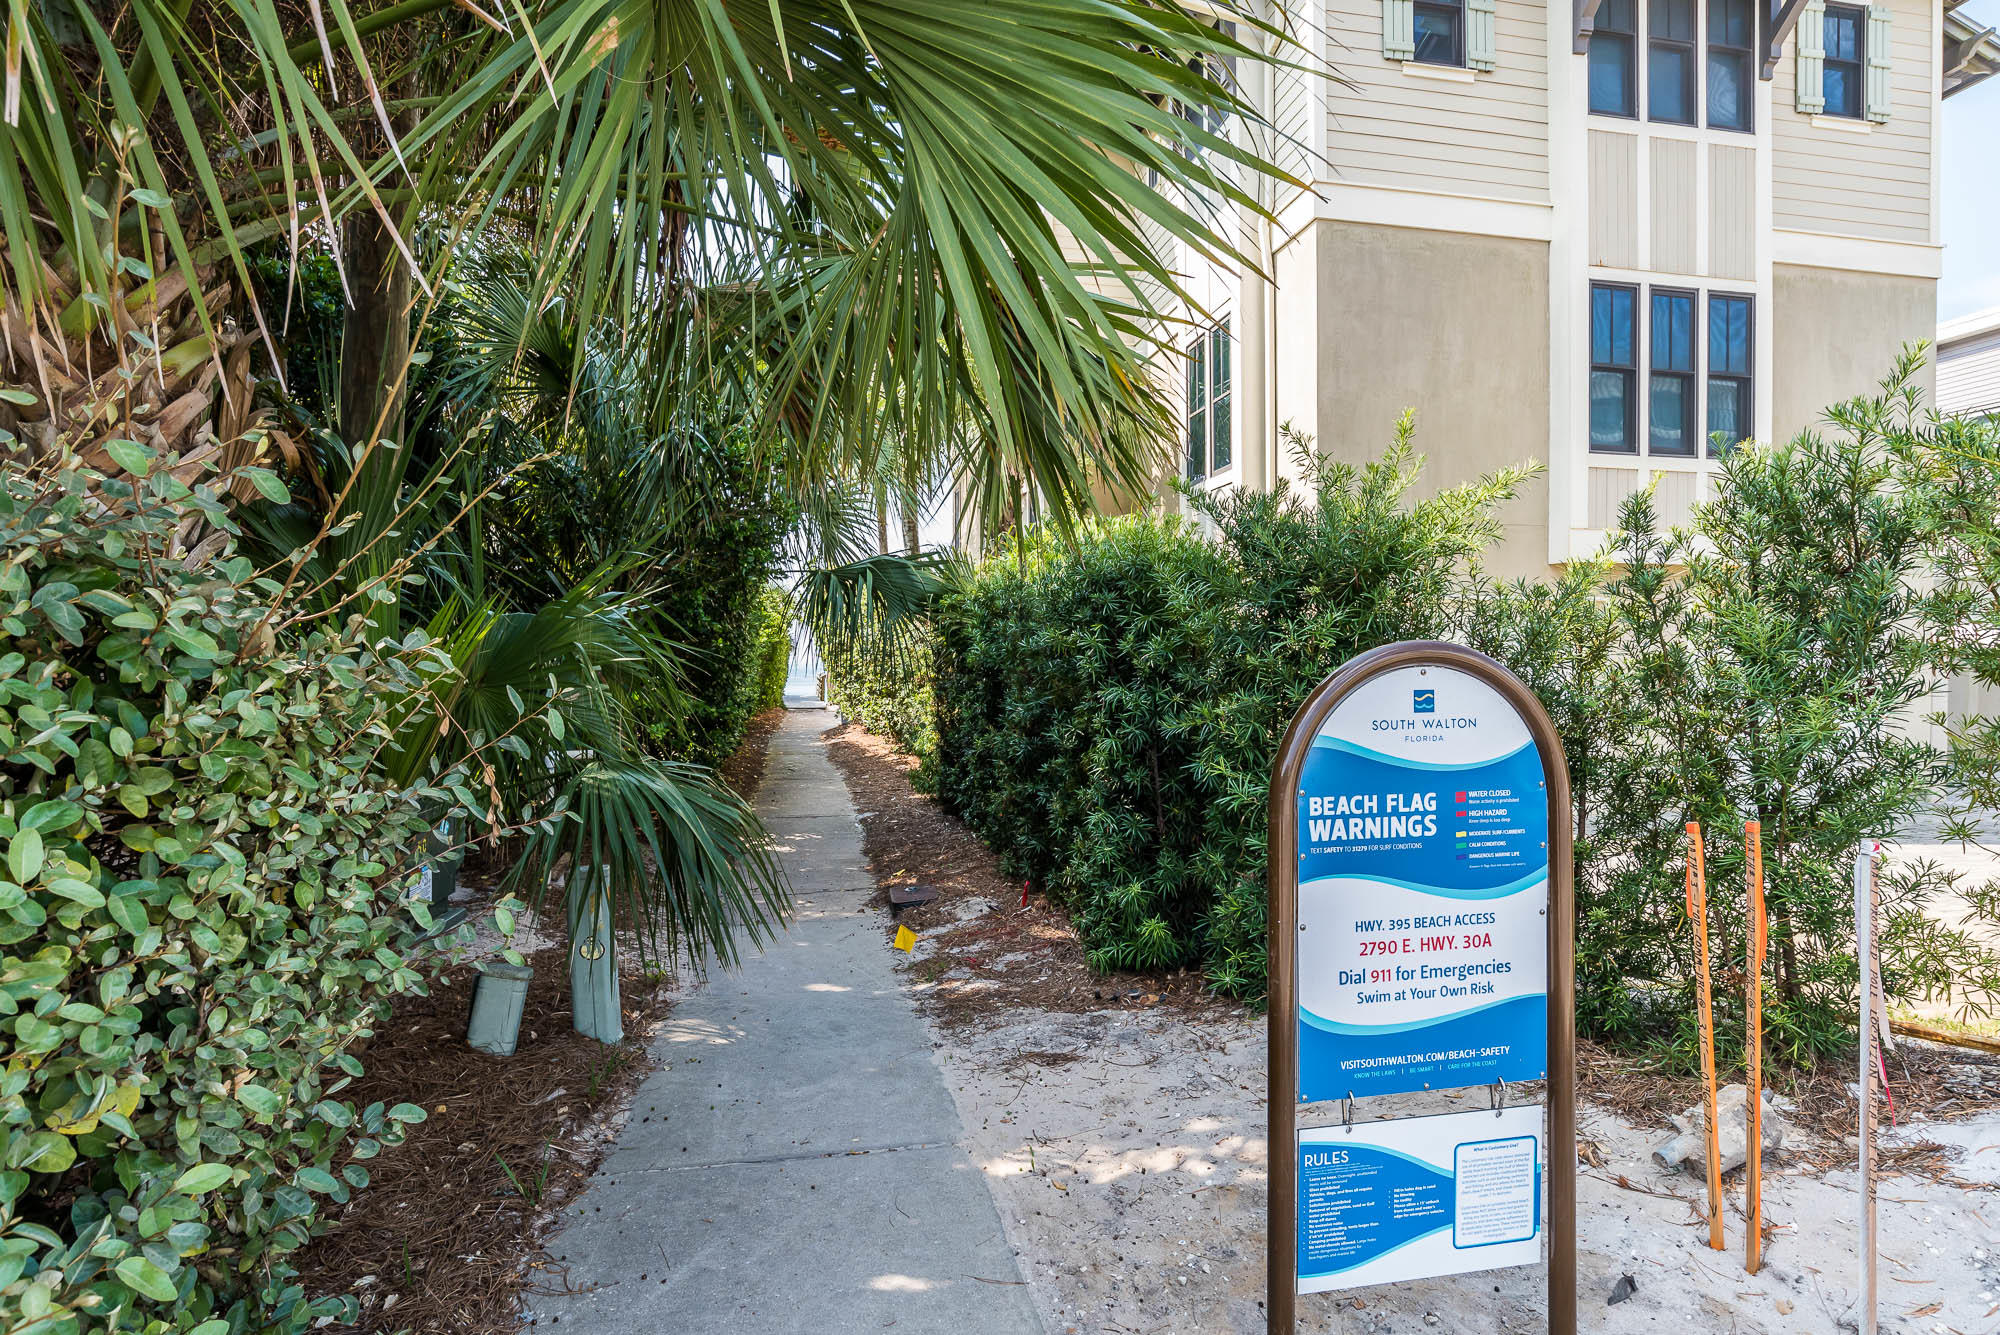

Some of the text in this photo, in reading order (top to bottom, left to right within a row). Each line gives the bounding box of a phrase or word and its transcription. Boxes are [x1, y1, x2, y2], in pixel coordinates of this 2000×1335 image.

[1372, 718, 1478, 731] SOUTH WALTON
[1310, 792, 1436, 816] BEACH FLAG
[1308, 814, 1437, 842] WARNINGS
[1355, 912, 1496, 932] HWY. 395 BEACH ACCESS
[1870, 902, 1878, 960] PROPOSED
[1359, 932, 1492, 956] 2790 E. HWY. 30A
[1338, 959, 1512, 986] Dial 911 for Emergencies
[1869, 969, 1878, 998] POLE
[1357, 981, 1494, 1004] Swim at Your Own Risk
[1868, 1008, 1878, 1078] LOCATION
[1340, 1044, 1510, 1070] VISITSOUTHWALTON.COM/BEACH-SAFETY
[1868, 1126, 1877, 1150] NOT
[1304, 1150, 1349, 1168] RULES
[1868, 1157, 1877, 1204] CLEAR
